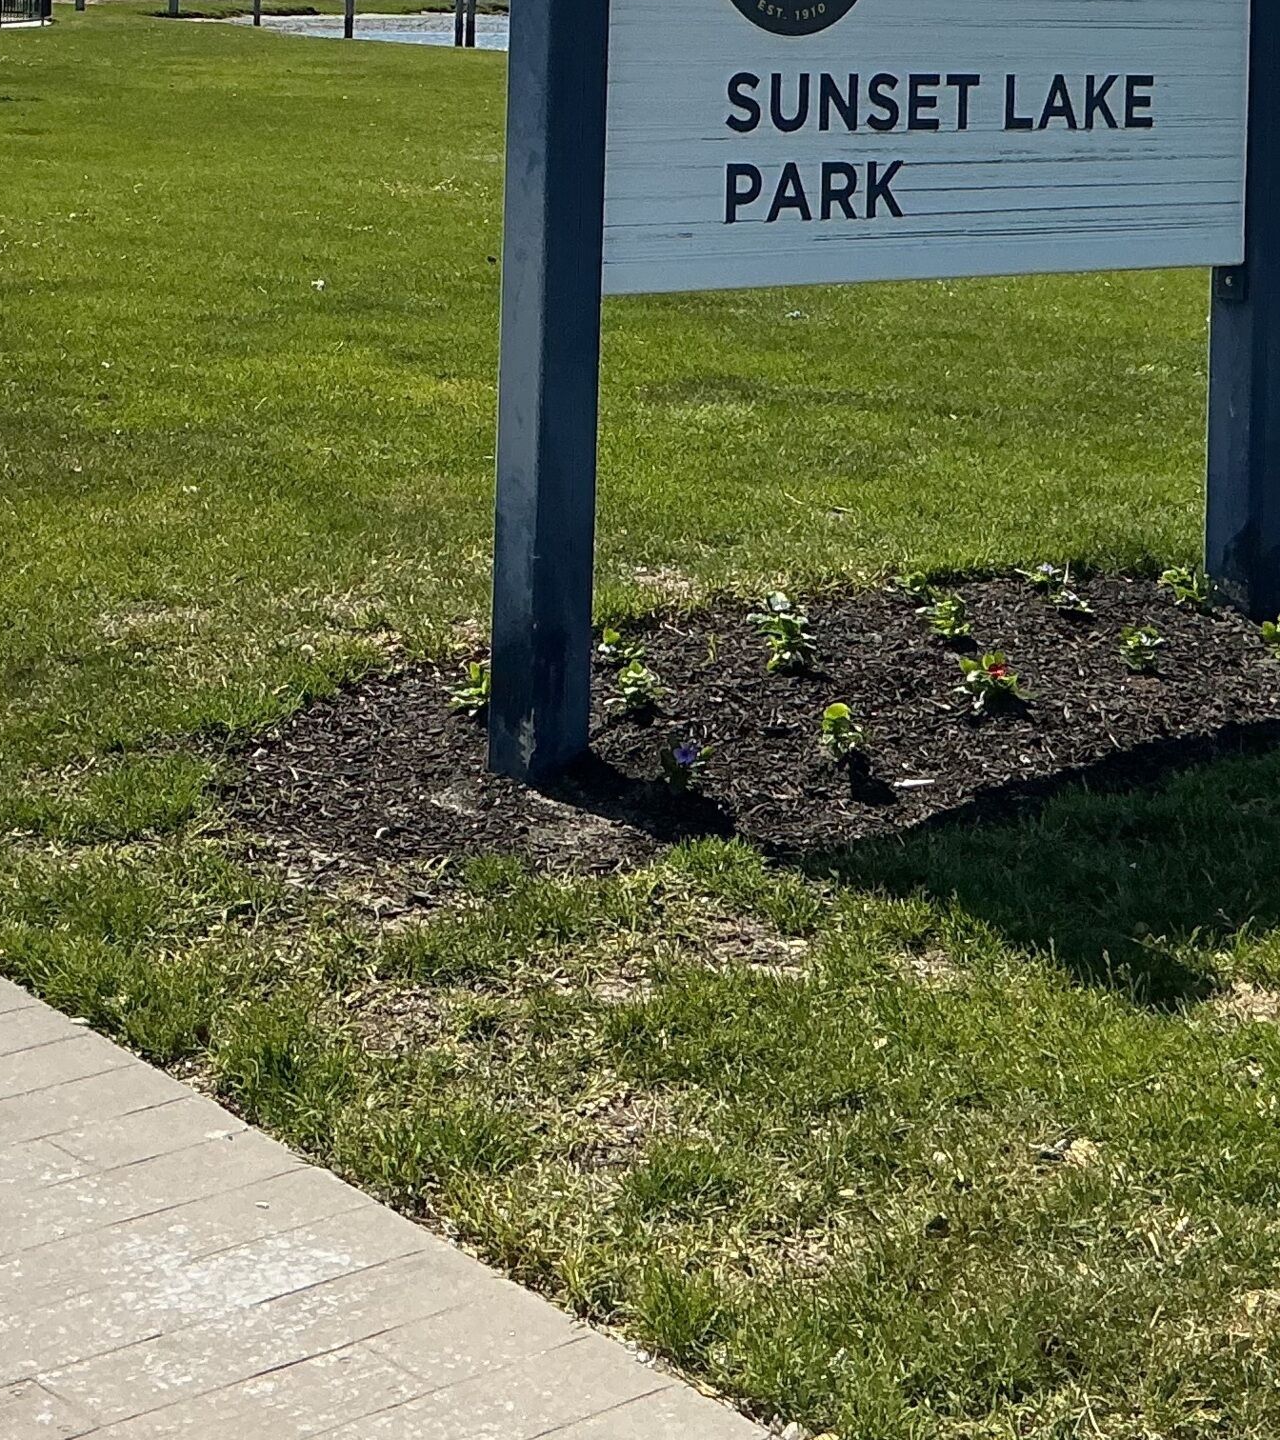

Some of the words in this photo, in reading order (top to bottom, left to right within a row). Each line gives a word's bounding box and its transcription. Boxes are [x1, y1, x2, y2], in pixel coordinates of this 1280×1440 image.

[757, 0, 787, 20] EST.
[794, 2, 826, 21] 1910
[725, 71, 980, 132] SUNSET
[1004, 73, 1154, 130] LAKE
[723, 160, 904, 223] PARK
